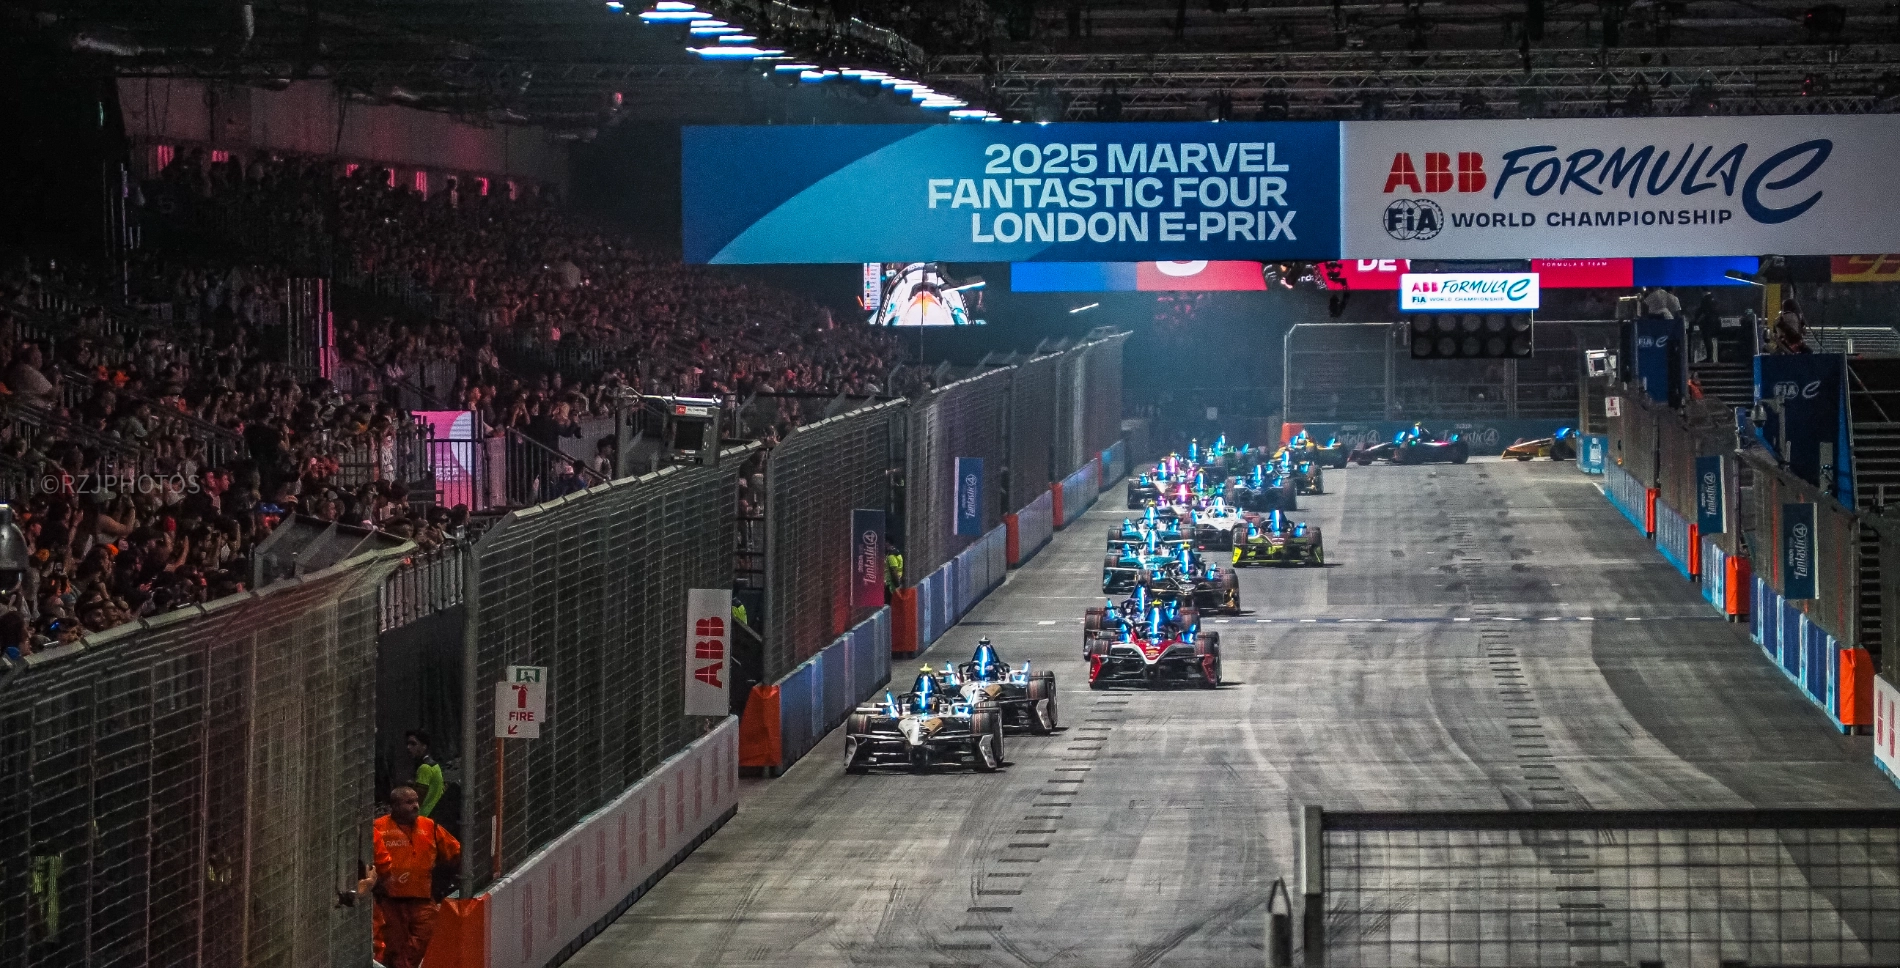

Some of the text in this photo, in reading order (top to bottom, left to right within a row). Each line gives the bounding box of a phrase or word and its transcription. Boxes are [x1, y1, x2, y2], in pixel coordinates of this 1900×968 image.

[985, 142, 1290, 175] 2025 MARVEL
[1383, 152, 1487, 193] ABB
[1493, 142, 1749, 199] FORMULA
[928, 176, 1288, 209] FANTASTIC FOUR
[972, 210, 1298, 243] LONDON E-PRIX
[1452, 212, 1536, 227] WORLD
[1546, 209, 1732, 227] CHAMPIONSHIP
[1411, 295, 1427, 303] FIA
[1412, 281, 1439, 292] ABB
[1440, 279, 1509, 293] FORMULA
[694, 616, 725, 689] ABB
[508, 711, 535, 722] FIRE
